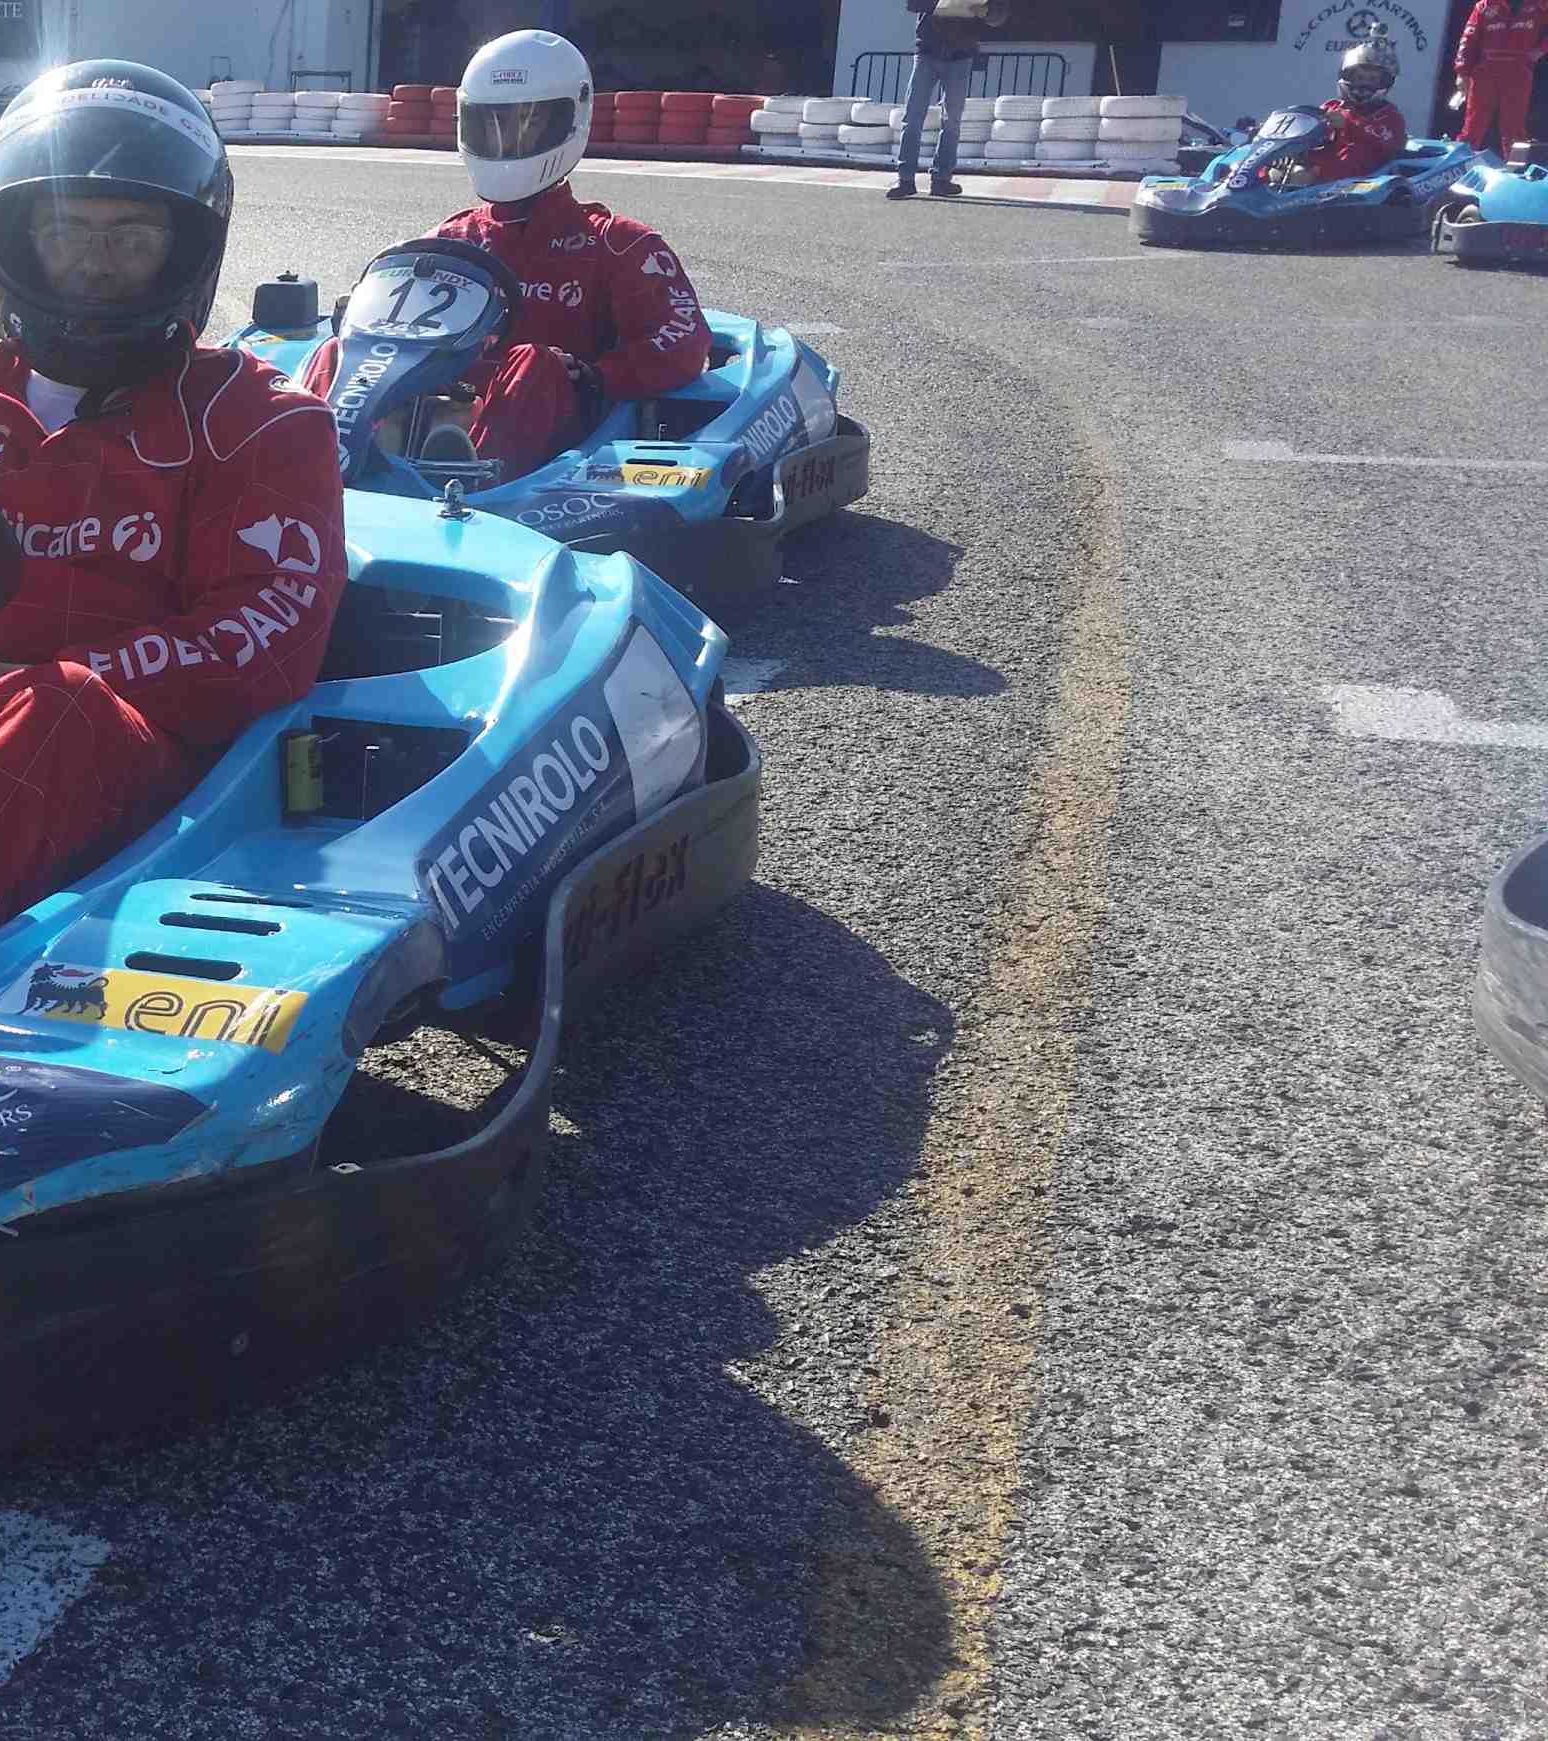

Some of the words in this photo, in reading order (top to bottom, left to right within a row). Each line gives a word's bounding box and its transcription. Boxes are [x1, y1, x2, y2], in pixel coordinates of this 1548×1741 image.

[388, 278, 458, 330] 12
[740, 394, 797, 457] NIROLO
[633, 466, 705, 488] eni
[516, 492, 617, 526] OSOC
[425, 715, 610, 934] TECNIROLO
[123, 990, 282, 1047] eni
